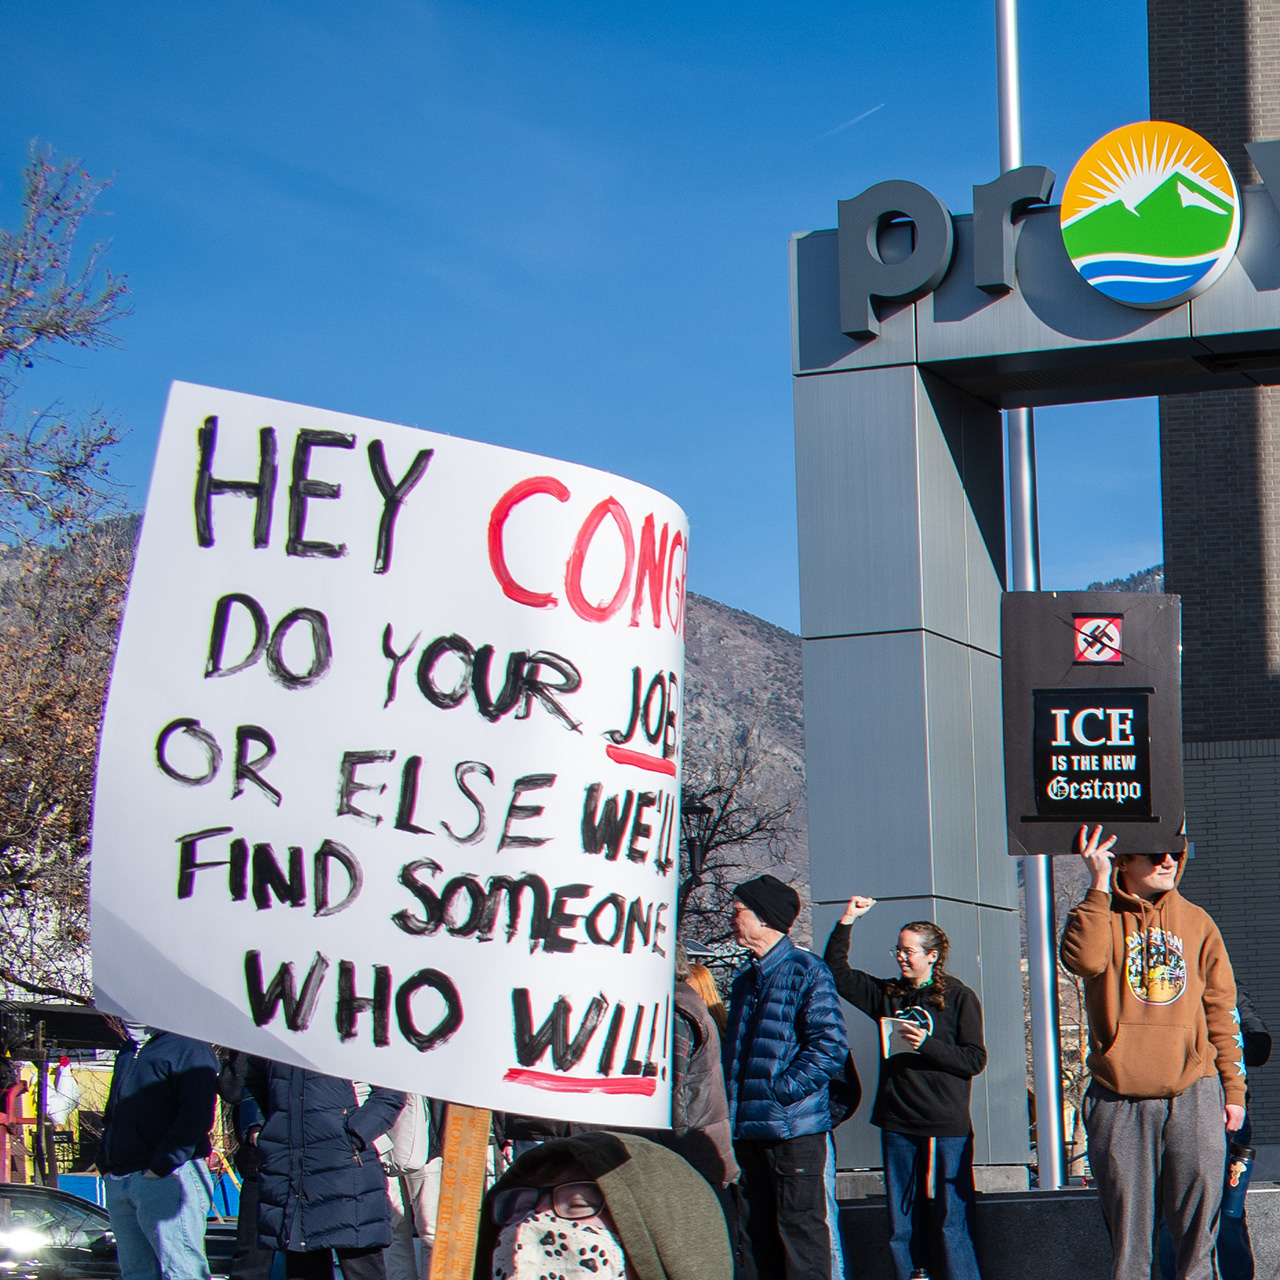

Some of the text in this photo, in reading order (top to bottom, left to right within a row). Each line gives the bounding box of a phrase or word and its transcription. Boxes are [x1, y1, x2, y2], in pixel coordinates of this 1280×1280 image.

[195, 414, 433, 574] HEY
[205, 592, 331, 691] DO
[382, 623, 583, 734] YOUR
[1050, 707, 1135, 746] ICE
[155, 717, 281, 806] OR
[336, 750, 556, 852] ELSE
[1051, 755, 1136, 771] IS THE NEW
[1047, 776, 1142, 804] Gestapo
[176, 826, 669, 958] FIND SOMEONE
[243, 950, 463, 1051] WHO
[448, 1116, 464, 1165] HOME
[444, 1168, 457, 1190] OF
[440, 1195, 454, 1225] THE
